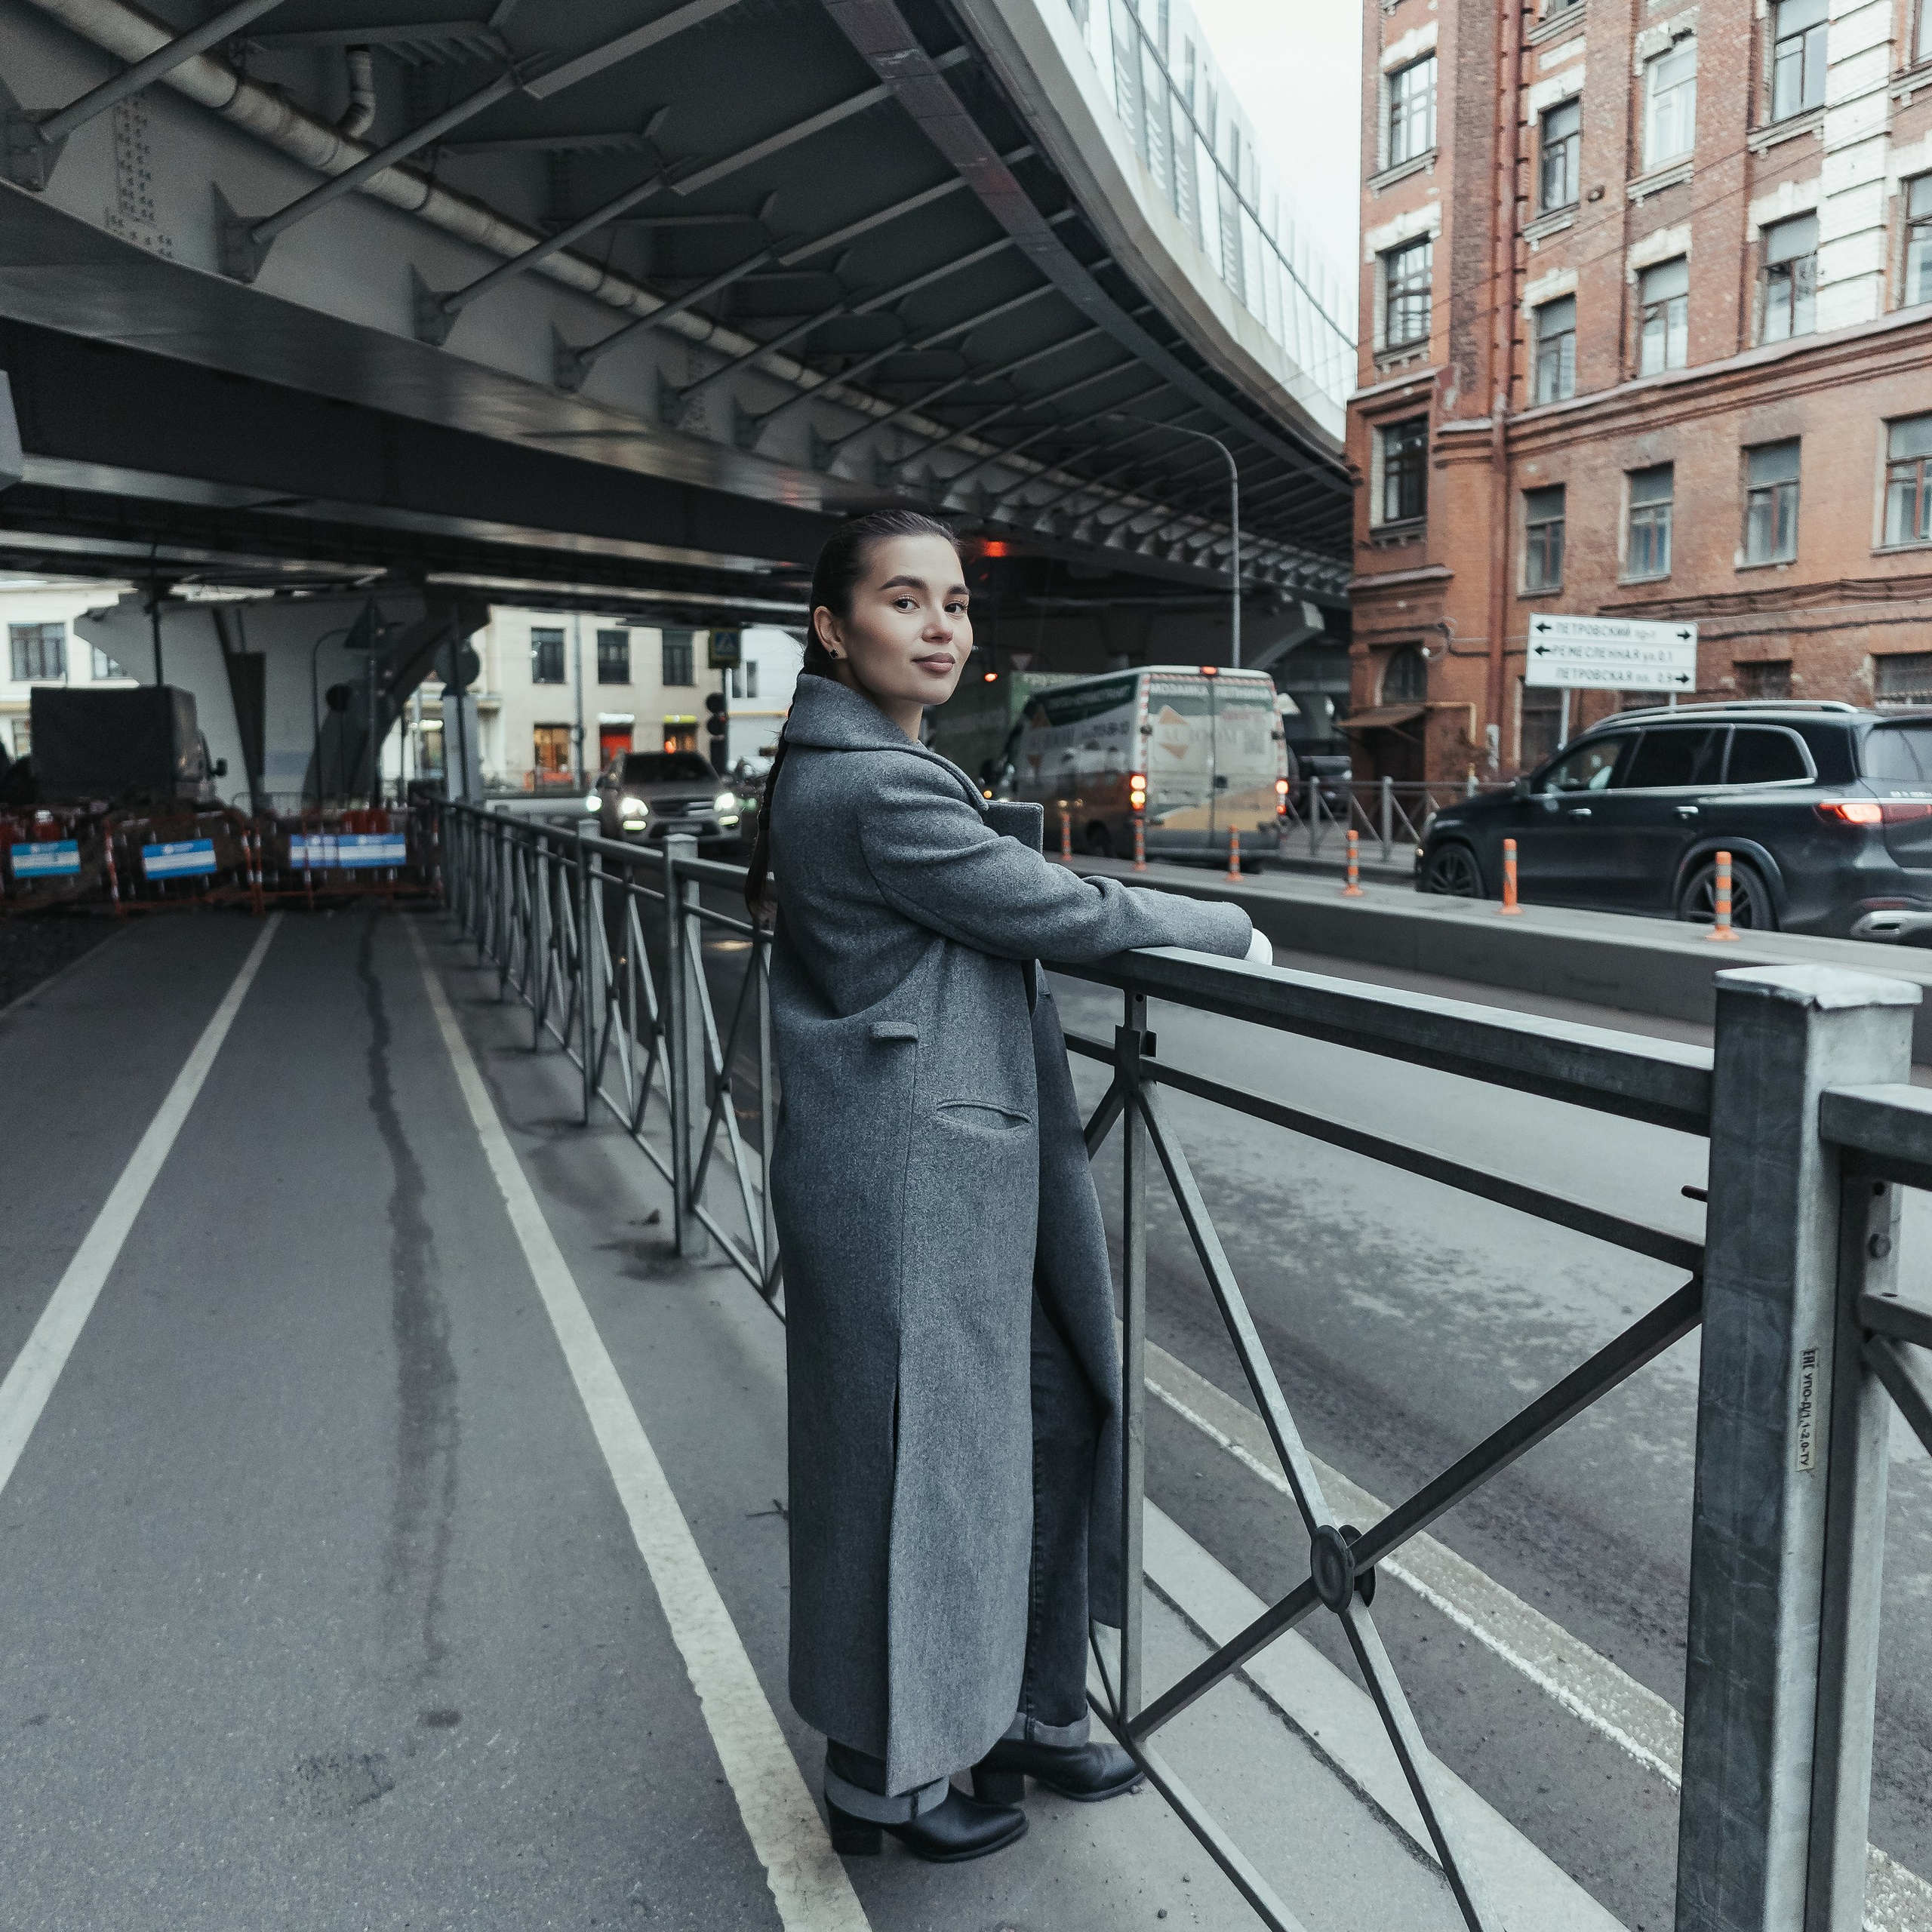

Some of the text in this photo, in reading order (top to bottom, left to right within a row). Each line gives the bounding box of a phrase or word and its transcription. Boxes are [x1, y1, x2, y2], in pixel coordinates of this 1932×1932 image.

[1556, 622, 1632, 637] ПЕТРОВСКИЙ
[1552, 645, 1640, 660] РЕМЕСЛЕННАЯ
[1555, 666, 1633, 681] ПЕТРОВСКАЯ
